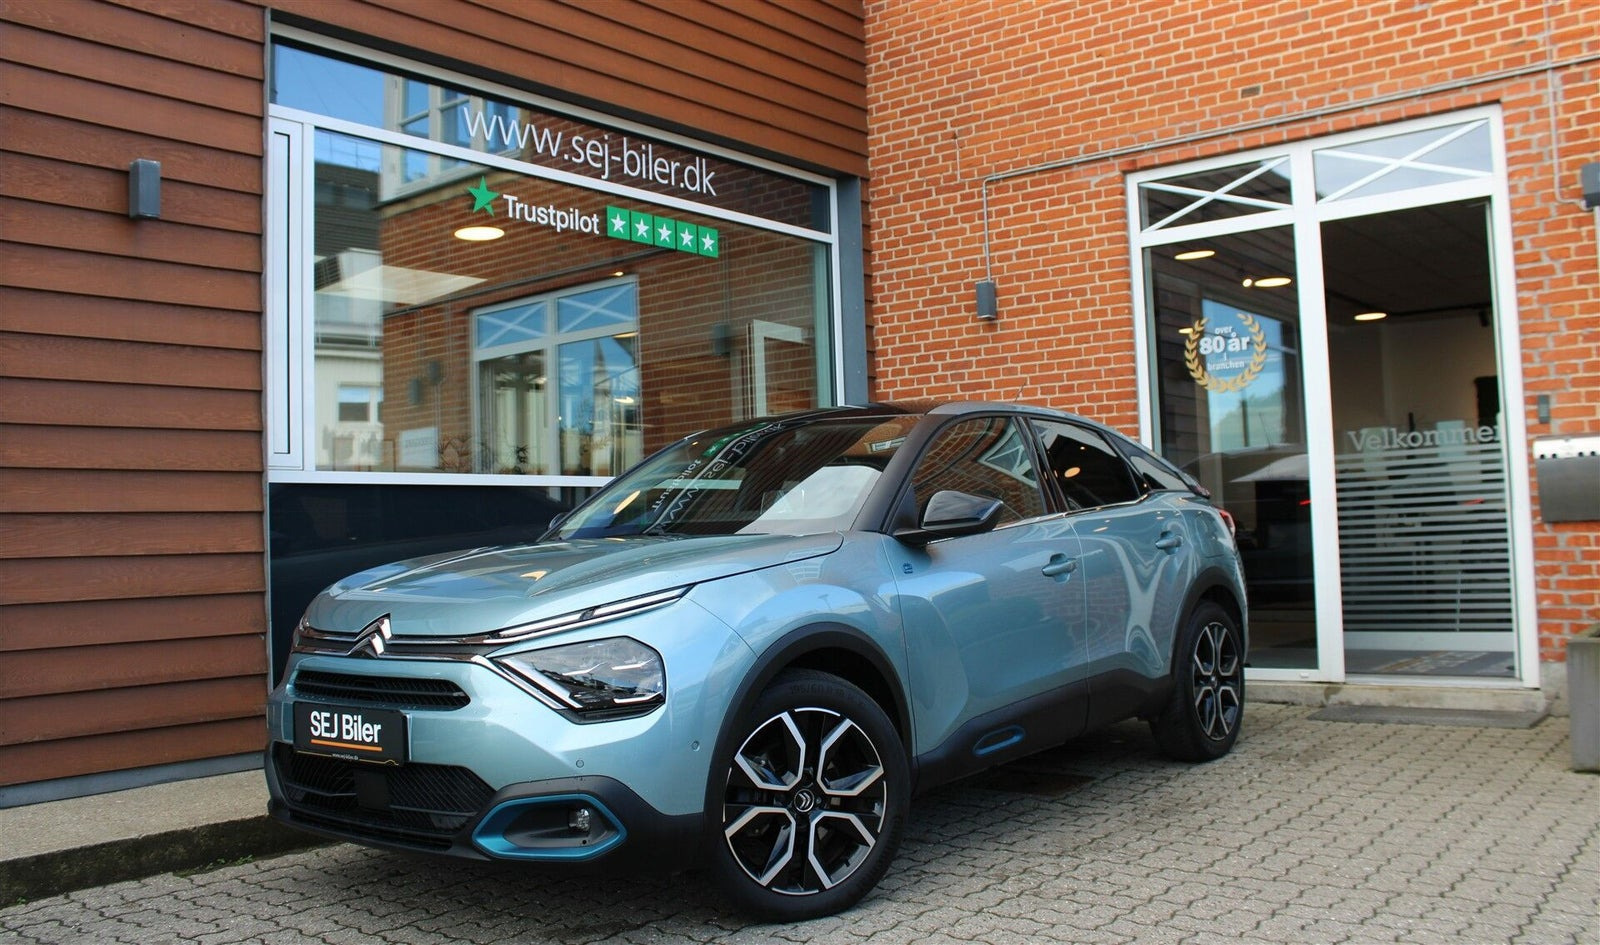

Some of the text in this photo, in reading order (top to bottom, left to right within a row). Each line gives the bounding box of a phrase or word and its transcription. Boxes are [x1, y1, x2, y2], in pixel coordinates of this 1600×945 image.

[463, 107, 717, 196] www.sej-biler.dk
[503, 194, 600, 234] Trustpilot
[1199, 332, 1250, 355] 80 år
[1214, 326, 1233, 334] over
[1206, 361, 1245, 371] branchen
[310, 711, 382, 743] SEJ Biler
